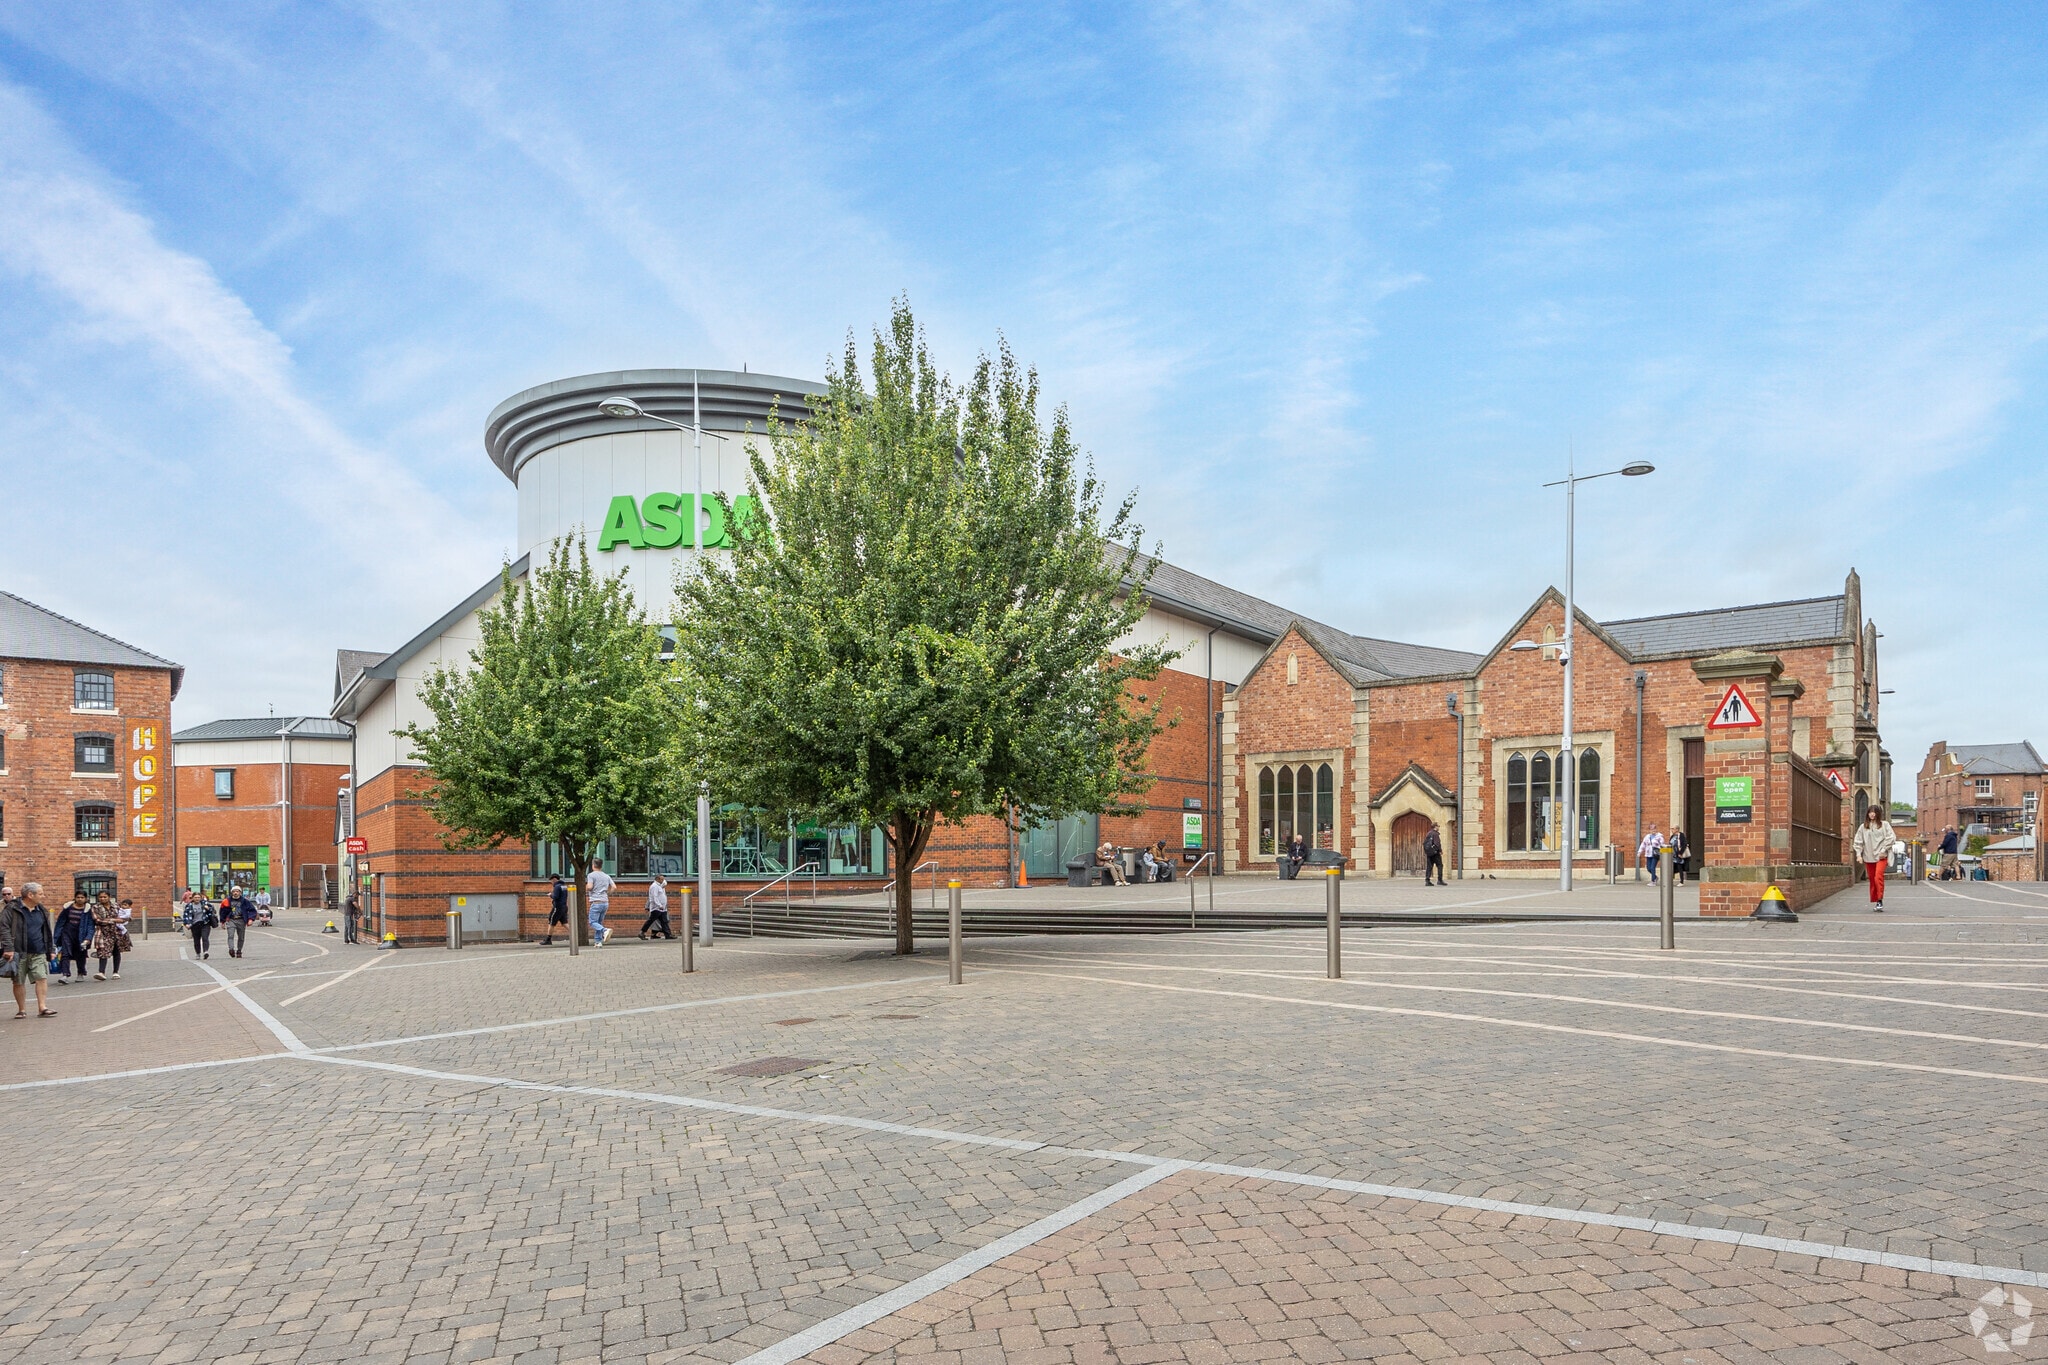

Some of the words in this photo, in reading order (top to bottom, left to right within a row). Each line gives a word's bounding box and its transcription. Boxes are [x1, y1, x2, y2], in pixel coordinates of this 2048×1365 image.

[597, 492, 775, 551] ASDA
[134, 726, 157, 837] HOPE
[1186, 816, 1200, 826] ASDA
